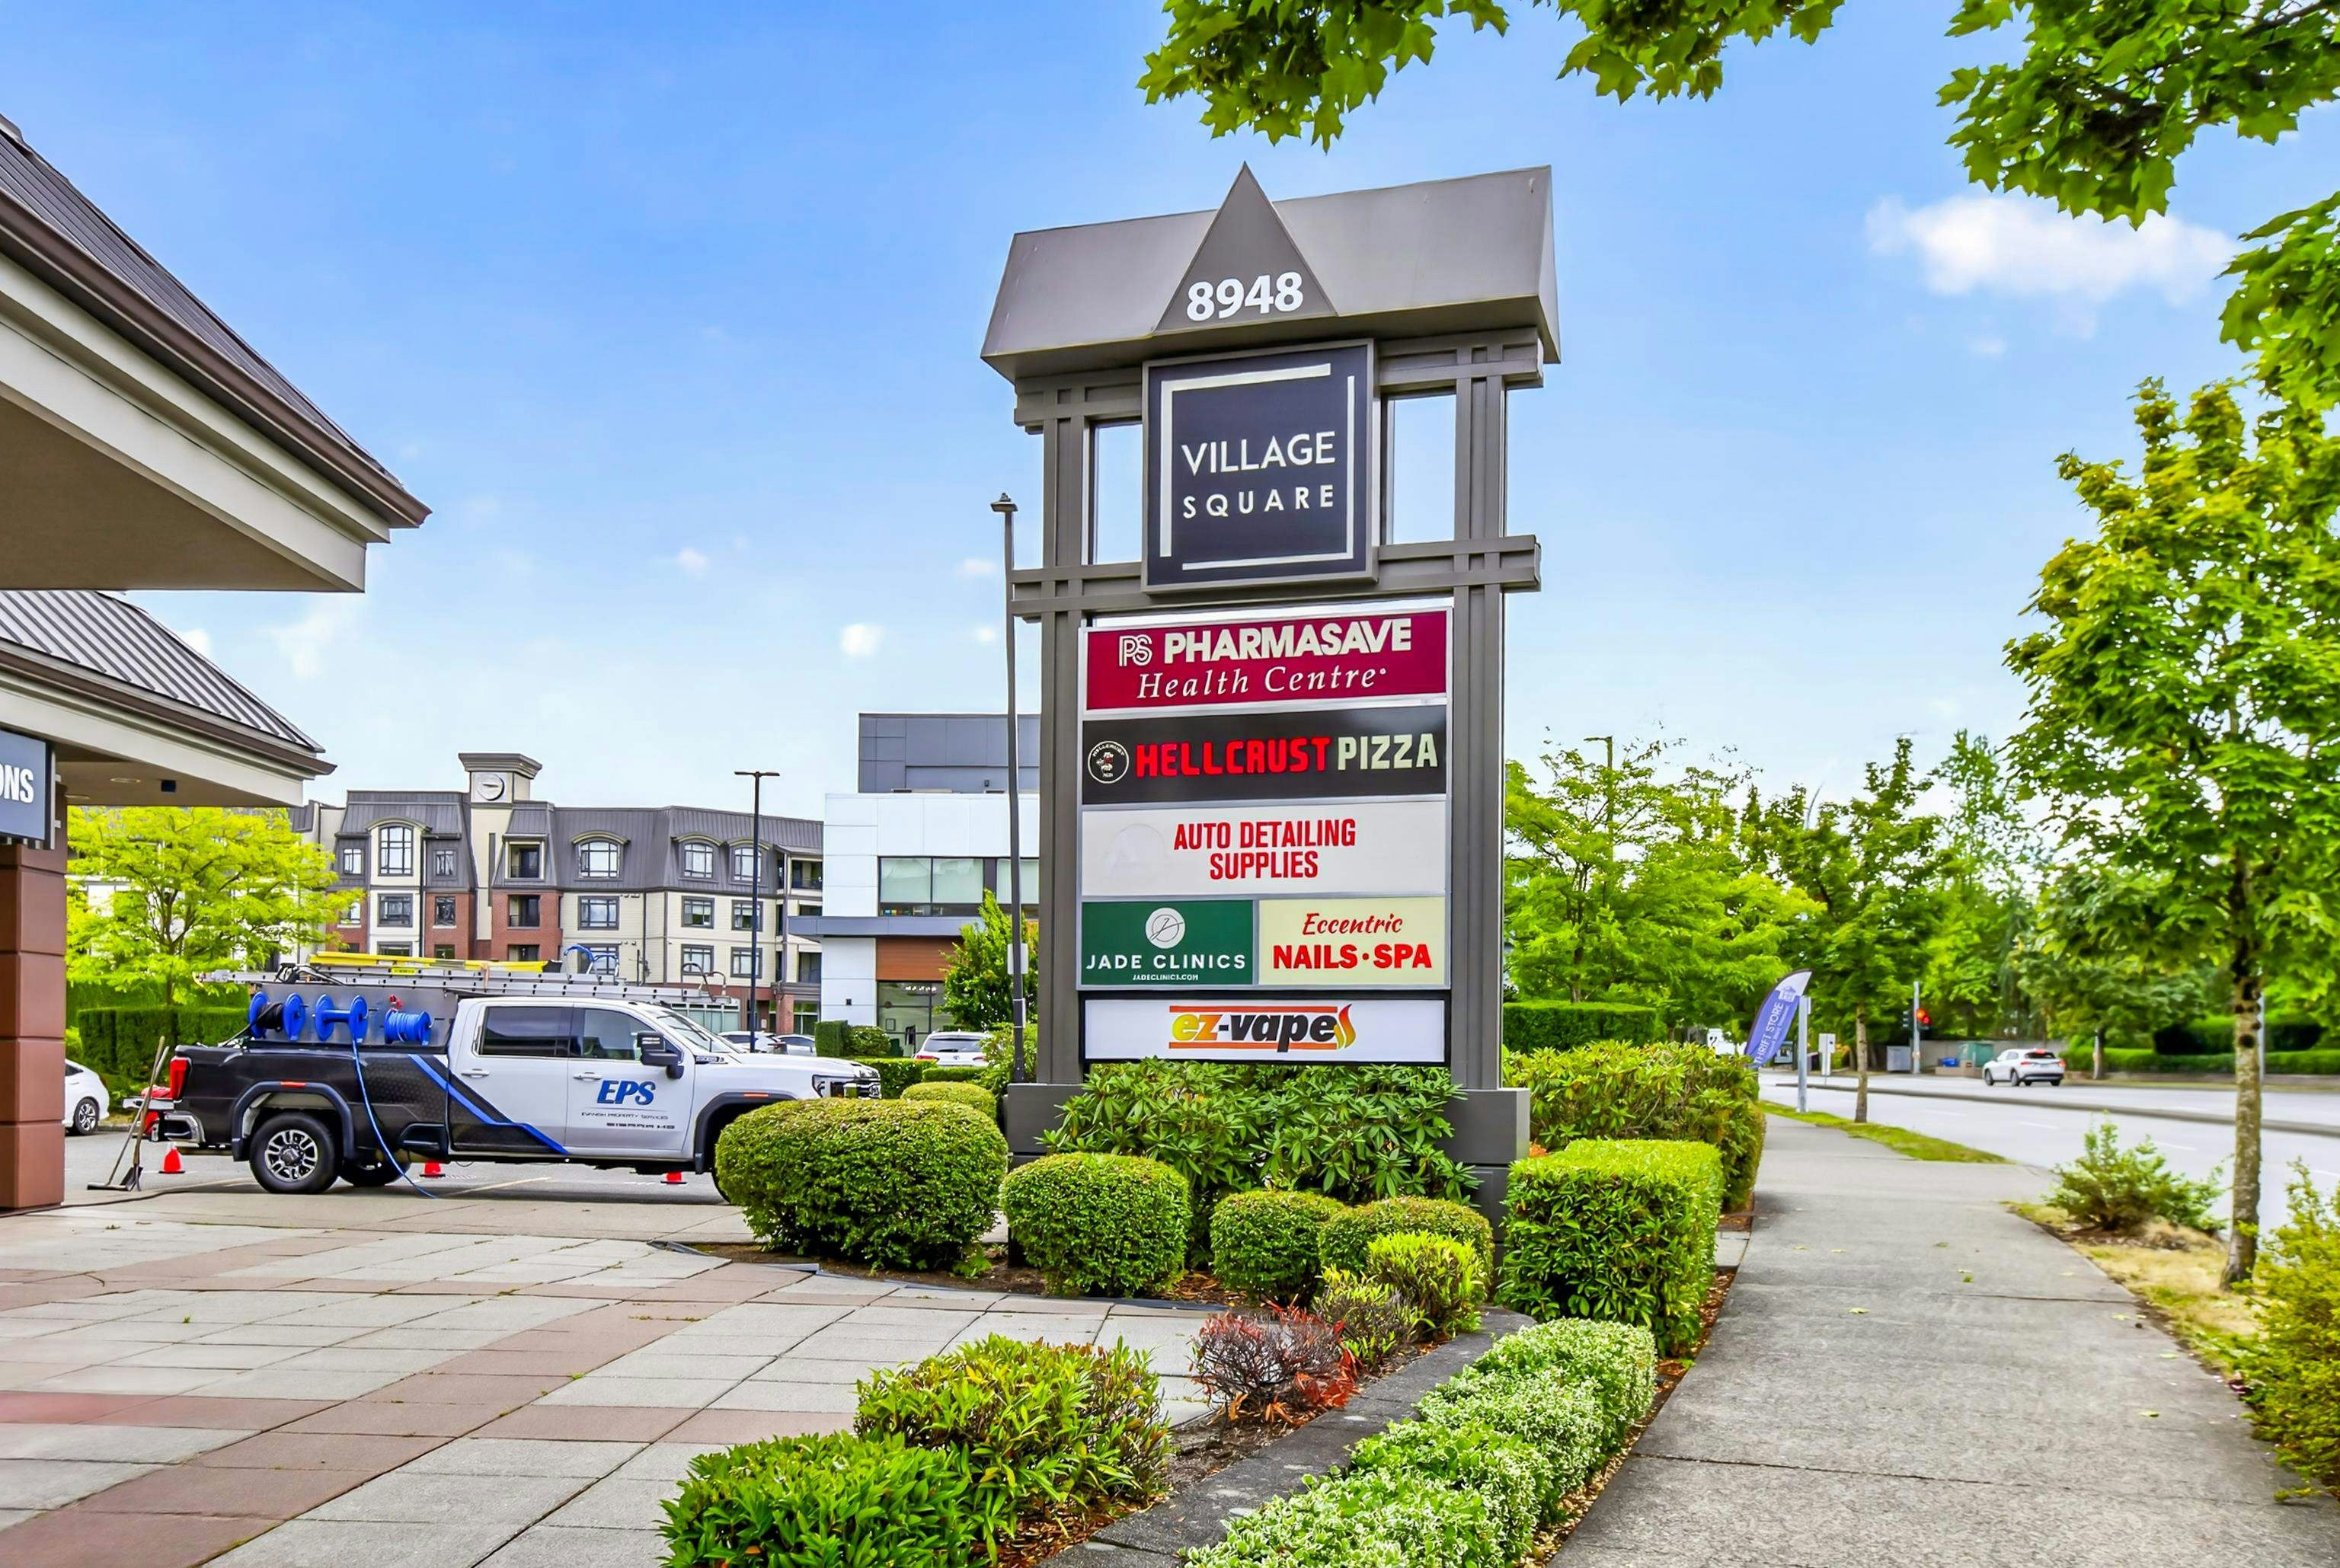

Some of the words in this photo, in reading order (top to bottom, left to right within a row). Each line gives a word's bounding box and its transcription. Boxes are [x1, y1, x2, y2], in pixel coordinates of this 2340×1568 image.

[1186, 271, 1303, 321] 8948
[1181, 431, 1335, 476] VILLAGE
[1183, 484, 1334, 519] SQUARE
[1164, 618, 1412, 665] PHARMASAVE
[1136, 667, 1249, 699] Health
[1136, 736, 1331, 778] HELLCRUST
[1338, 733, 1438, 771] PIZZA
[0, 763, 34, 804] NS
[1174, 822, 1231, 850] AUTO
[1239, 818, 1356, 848] DETAILING
[1210, 851, 1319, 880] SUPPLIES
[1302, 912, 1403, 935] Eccentric
[1086, 954, 1142, 969] JADE
[1152, 954, 1246, 969] CLINICS
[1766, 1001, 1784, 1033] STORE
[596, 1080, 656, 1106] EPS
